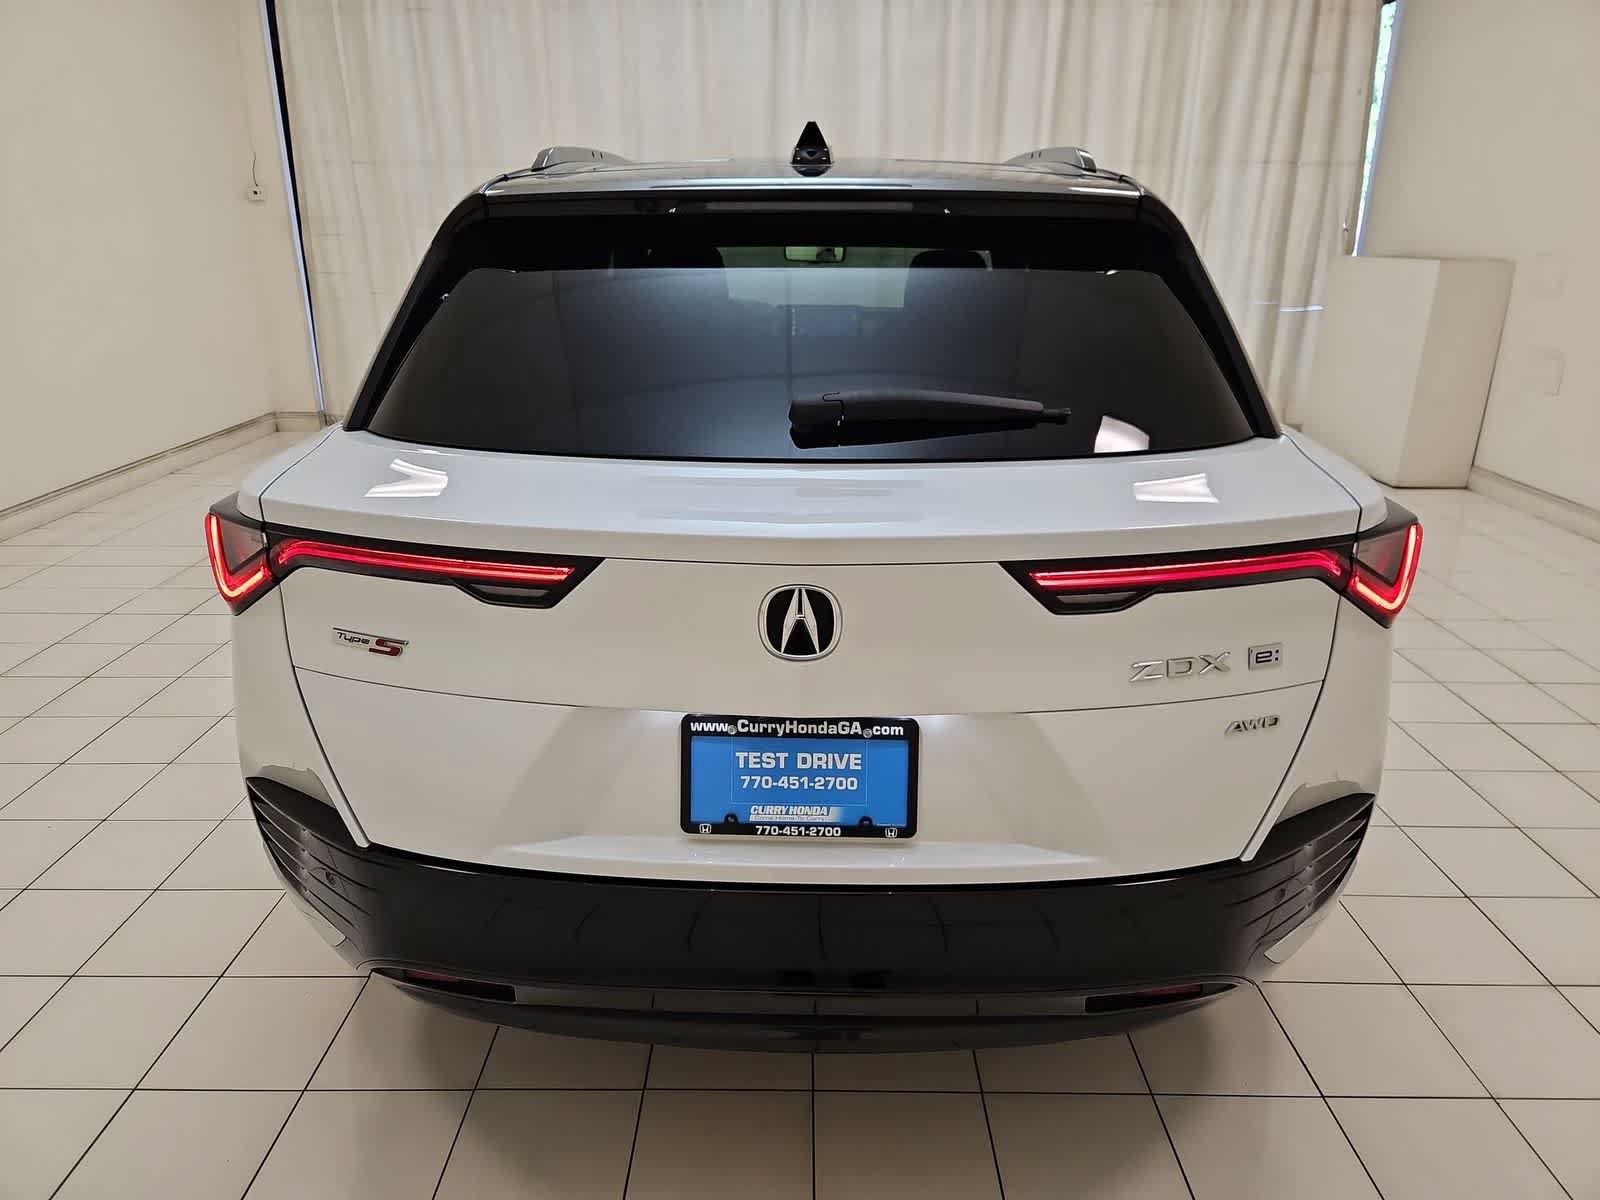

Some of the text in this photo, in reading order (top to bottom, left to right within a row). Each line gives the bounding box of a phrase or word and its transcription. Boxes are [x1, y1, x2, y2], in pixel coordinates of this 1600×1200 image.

[337, 631, 403, 657] Type S
[1129, 652, 1231, 682] ZDX
[690, 719, 904, 737] wwwCurryHondaGAcom
[1224, 715, 1280, 736] AWD
[735, 752, 862, 770] TEST DRIVE
[740, 776, 858, 790] 770-451-2700
[751, 805, 828, 816] CURRY HONDA
[755, 825, 841, 837] 770-451-2700
